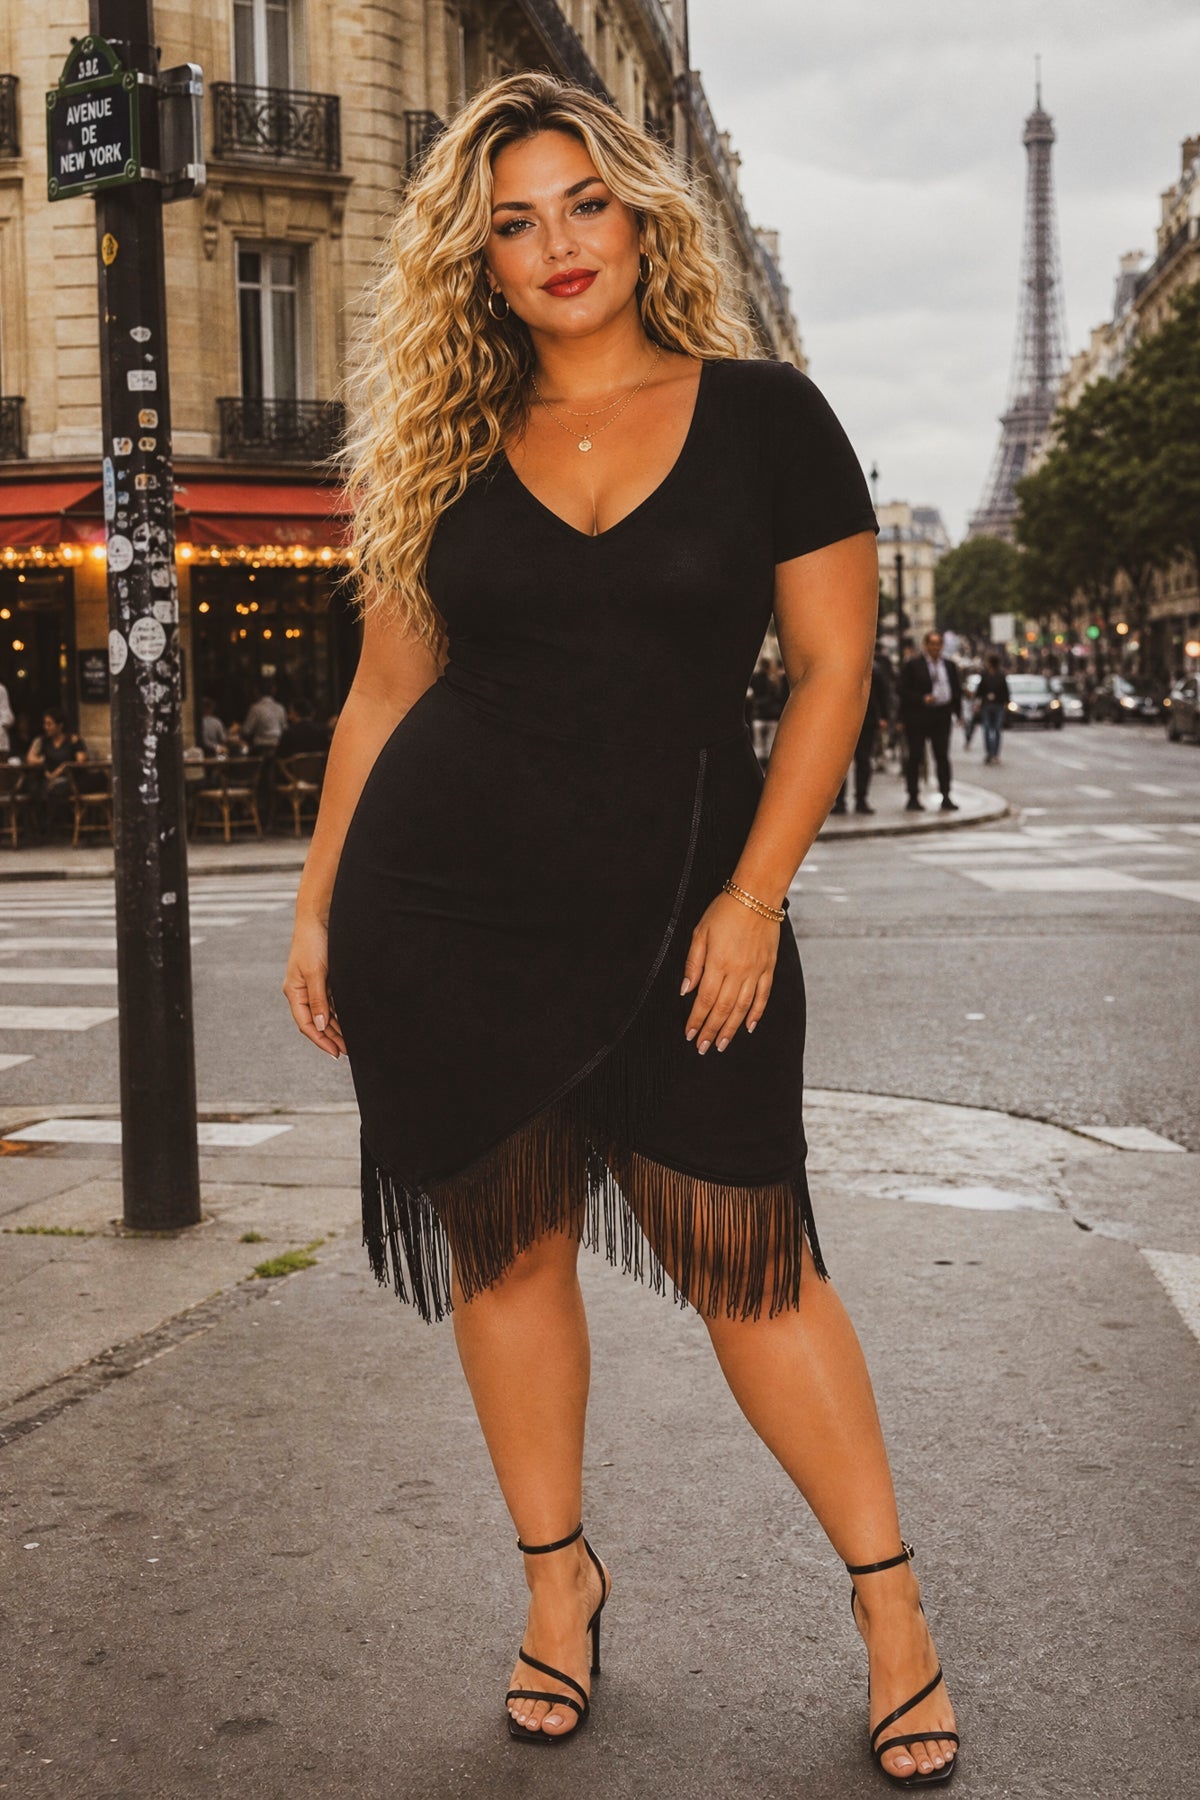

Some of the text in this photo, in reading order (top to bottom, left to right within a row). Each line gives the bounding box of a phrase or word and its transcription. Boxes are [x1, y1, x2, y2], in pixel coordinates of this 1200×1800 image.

[66, 97, 112, 125] AVENUE
[81, 125, 97, 146] DE
[60, 142, 122, 174] NEW YORK
